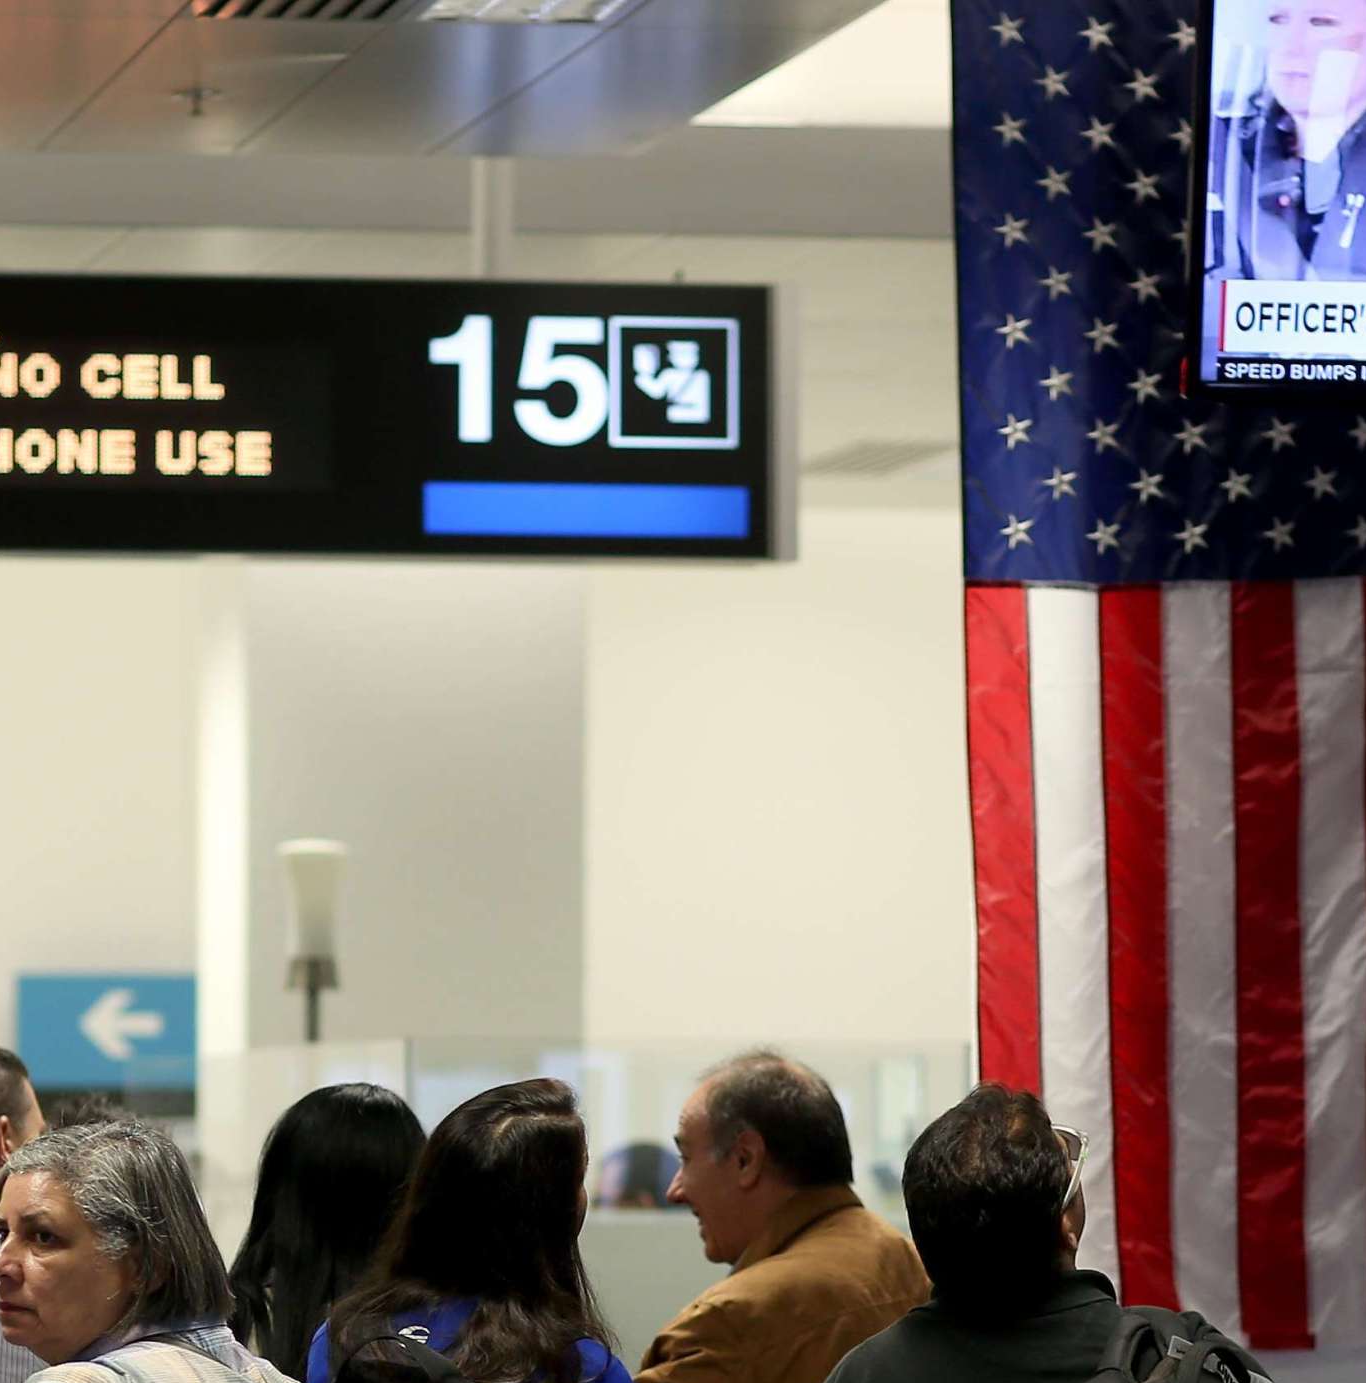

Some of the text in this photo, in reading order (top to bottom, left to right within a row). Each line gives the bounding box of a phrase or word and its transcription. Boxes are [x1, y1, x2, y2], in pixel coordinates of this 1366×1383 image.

[80, 353, 226, 401] CELL
[428, 314, 609, 447] 15
[1224, 362, 1286, 380] SPEED
[1289, 364, 1357, 381] BUMPS
[155, 429, 273, 477] USE
